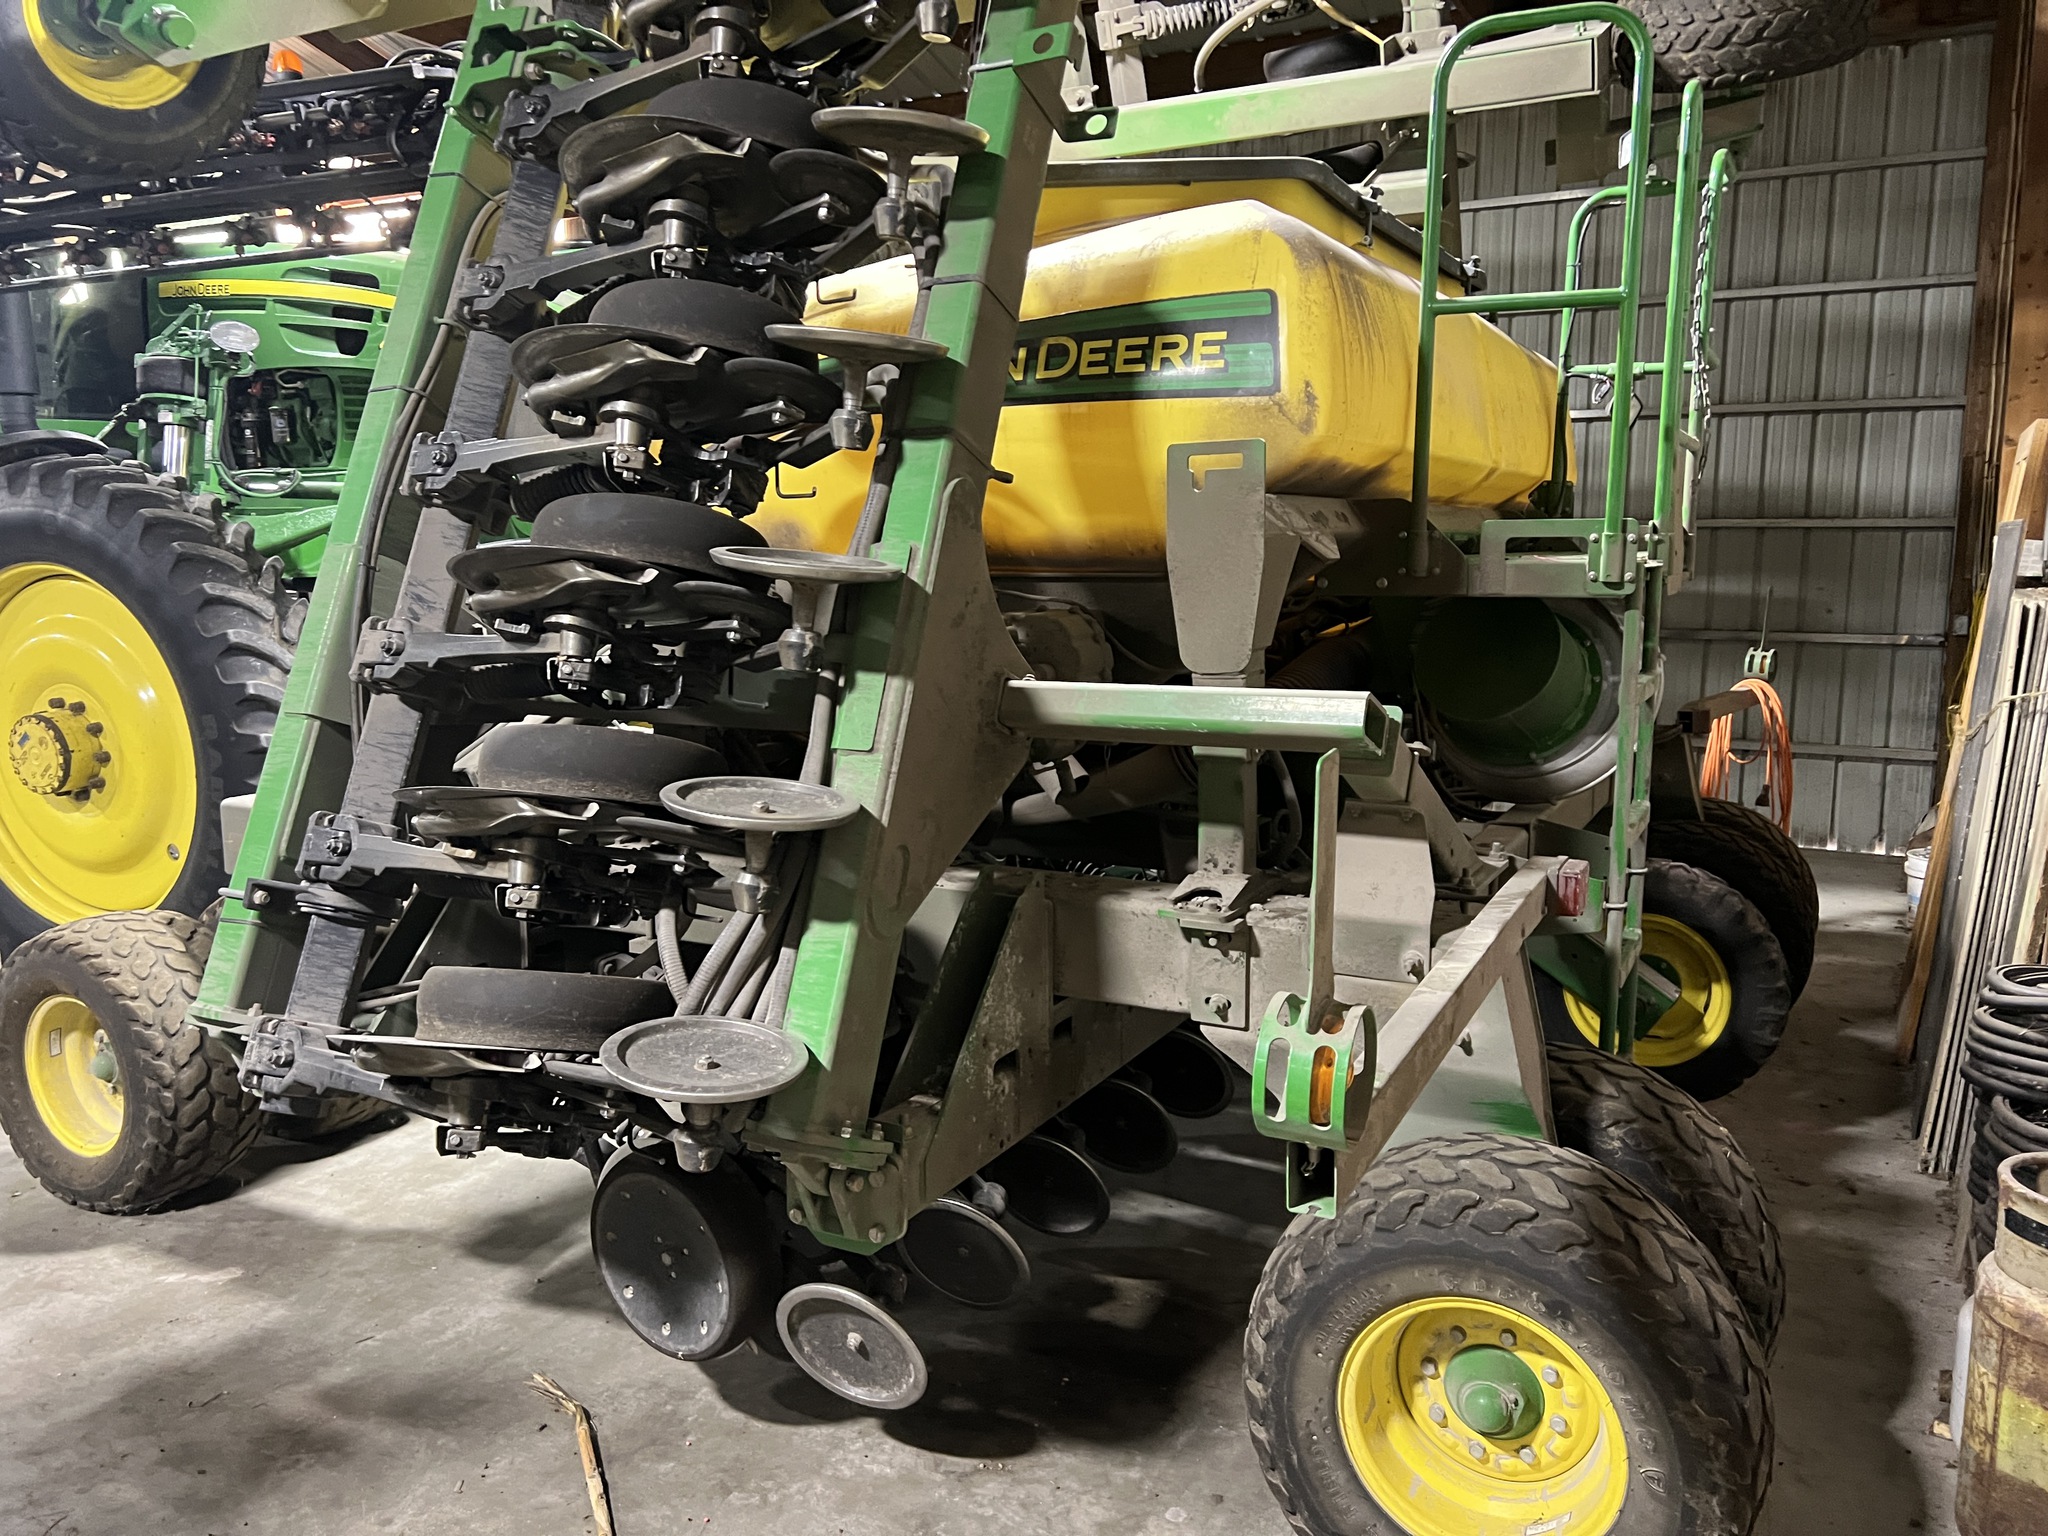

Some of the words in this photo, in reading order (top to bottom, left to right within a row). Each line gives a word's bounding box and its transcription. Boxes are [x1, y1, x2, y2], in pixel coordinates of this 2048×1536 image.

[172, 284, 197, 297] JOHN
[197, 283, 230, 295] DEERE
[1035, 331, 1228, 380] DEERE
